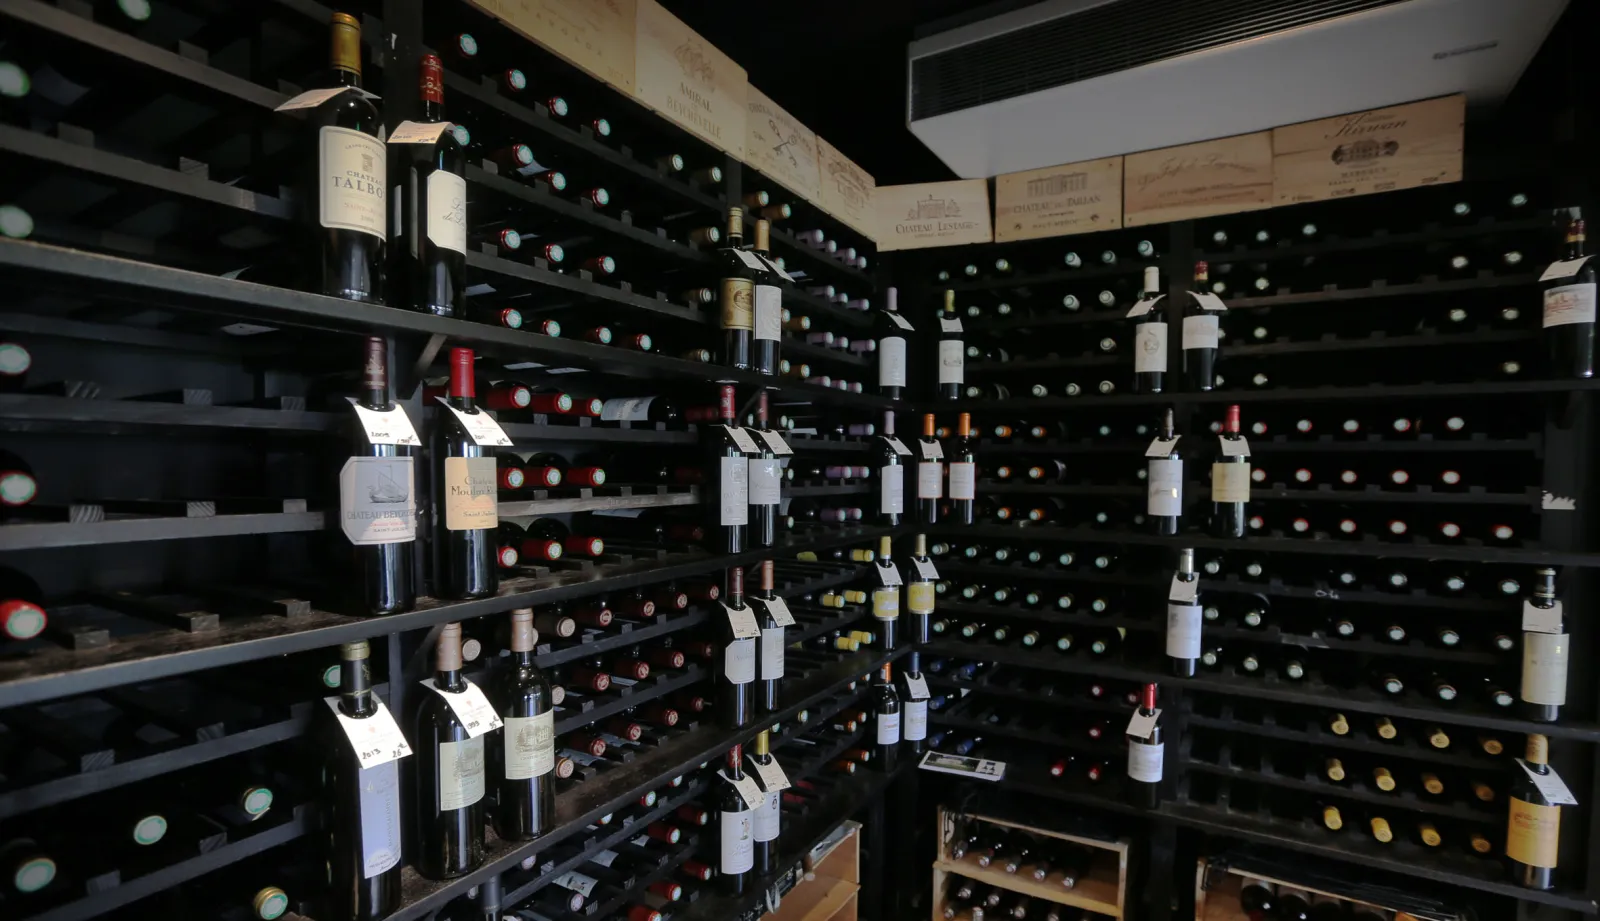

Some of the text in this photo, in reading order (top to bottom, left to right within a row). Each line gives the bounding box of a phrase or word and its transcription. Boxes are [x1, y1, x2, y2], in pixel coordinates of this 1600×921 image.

[680, 81, 713, 113] AMIRAL
[665, 95, 722, 139] BEYCHEVELLE
[895, 223, 932, 235] CHATEAU
[362, 748, 381, 760] 2013
